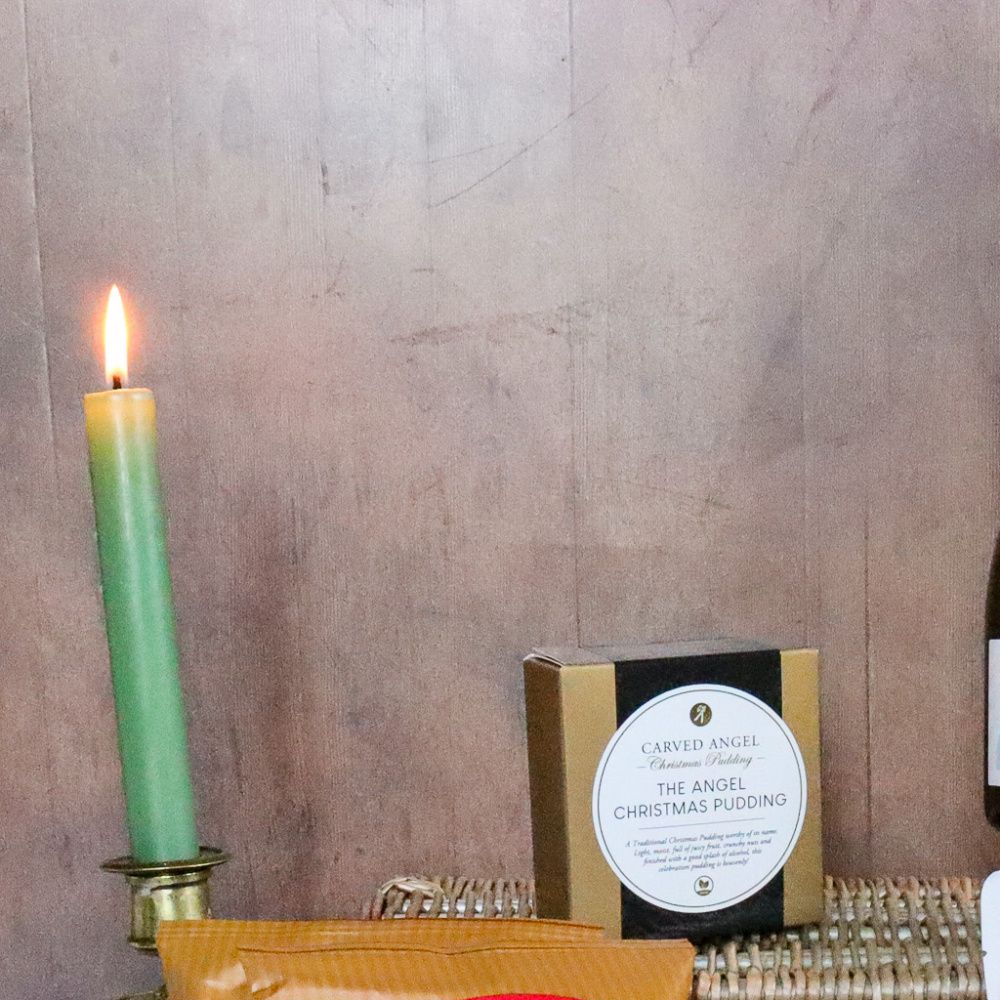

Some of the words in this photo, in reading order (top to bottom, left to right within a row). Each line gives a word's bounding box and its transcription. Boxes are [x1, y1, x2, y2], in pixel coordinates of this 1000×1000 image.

[641, 738, 704, 755] CARVED
[708, 734, 760, 750] ANGEL
[647, 755, 702, 772] Christmas
[705, 752, 753, 769] Pudding
[656, 780, 686, 796] THE
[691, 777, 747, 794] ANGEL
[613, 800, 708, 820] CHRISTMAS
[713, 793, 788, 812] PUDDING
